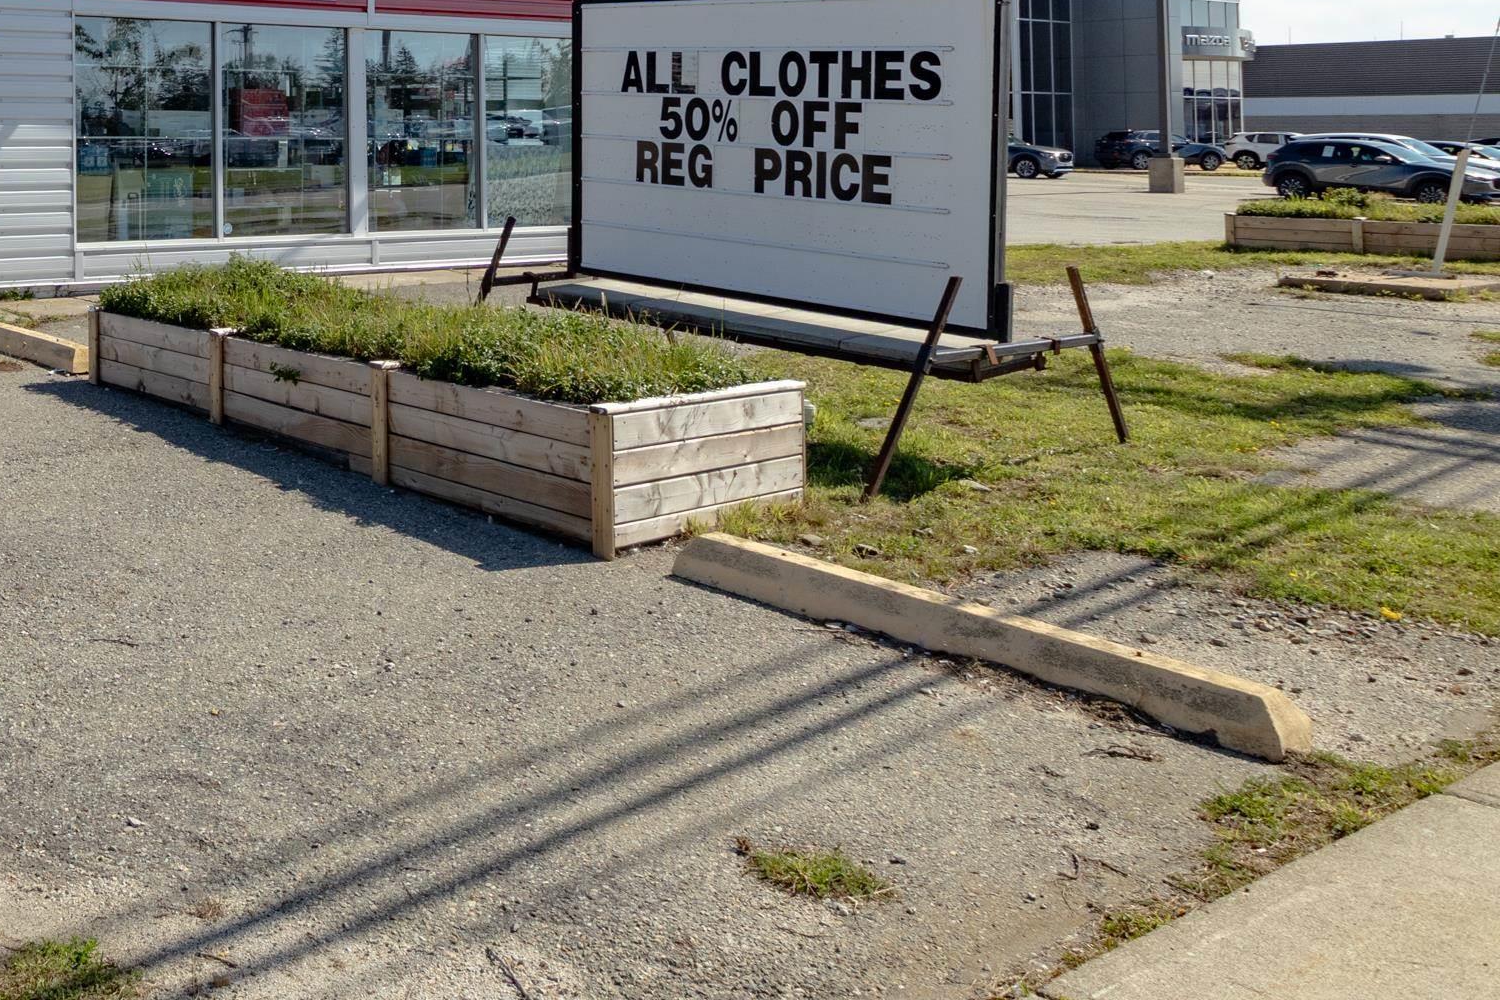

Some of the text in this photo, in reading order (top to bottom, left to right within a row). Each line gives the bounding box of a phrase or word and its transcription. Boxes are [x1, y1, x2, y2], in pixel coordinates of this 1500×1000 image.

[621, 50, 942, 101] ALL CLOTHES
[659, 96, 863, 150] 50% OFF
[635, 140, 893, 206] REG PRICE
